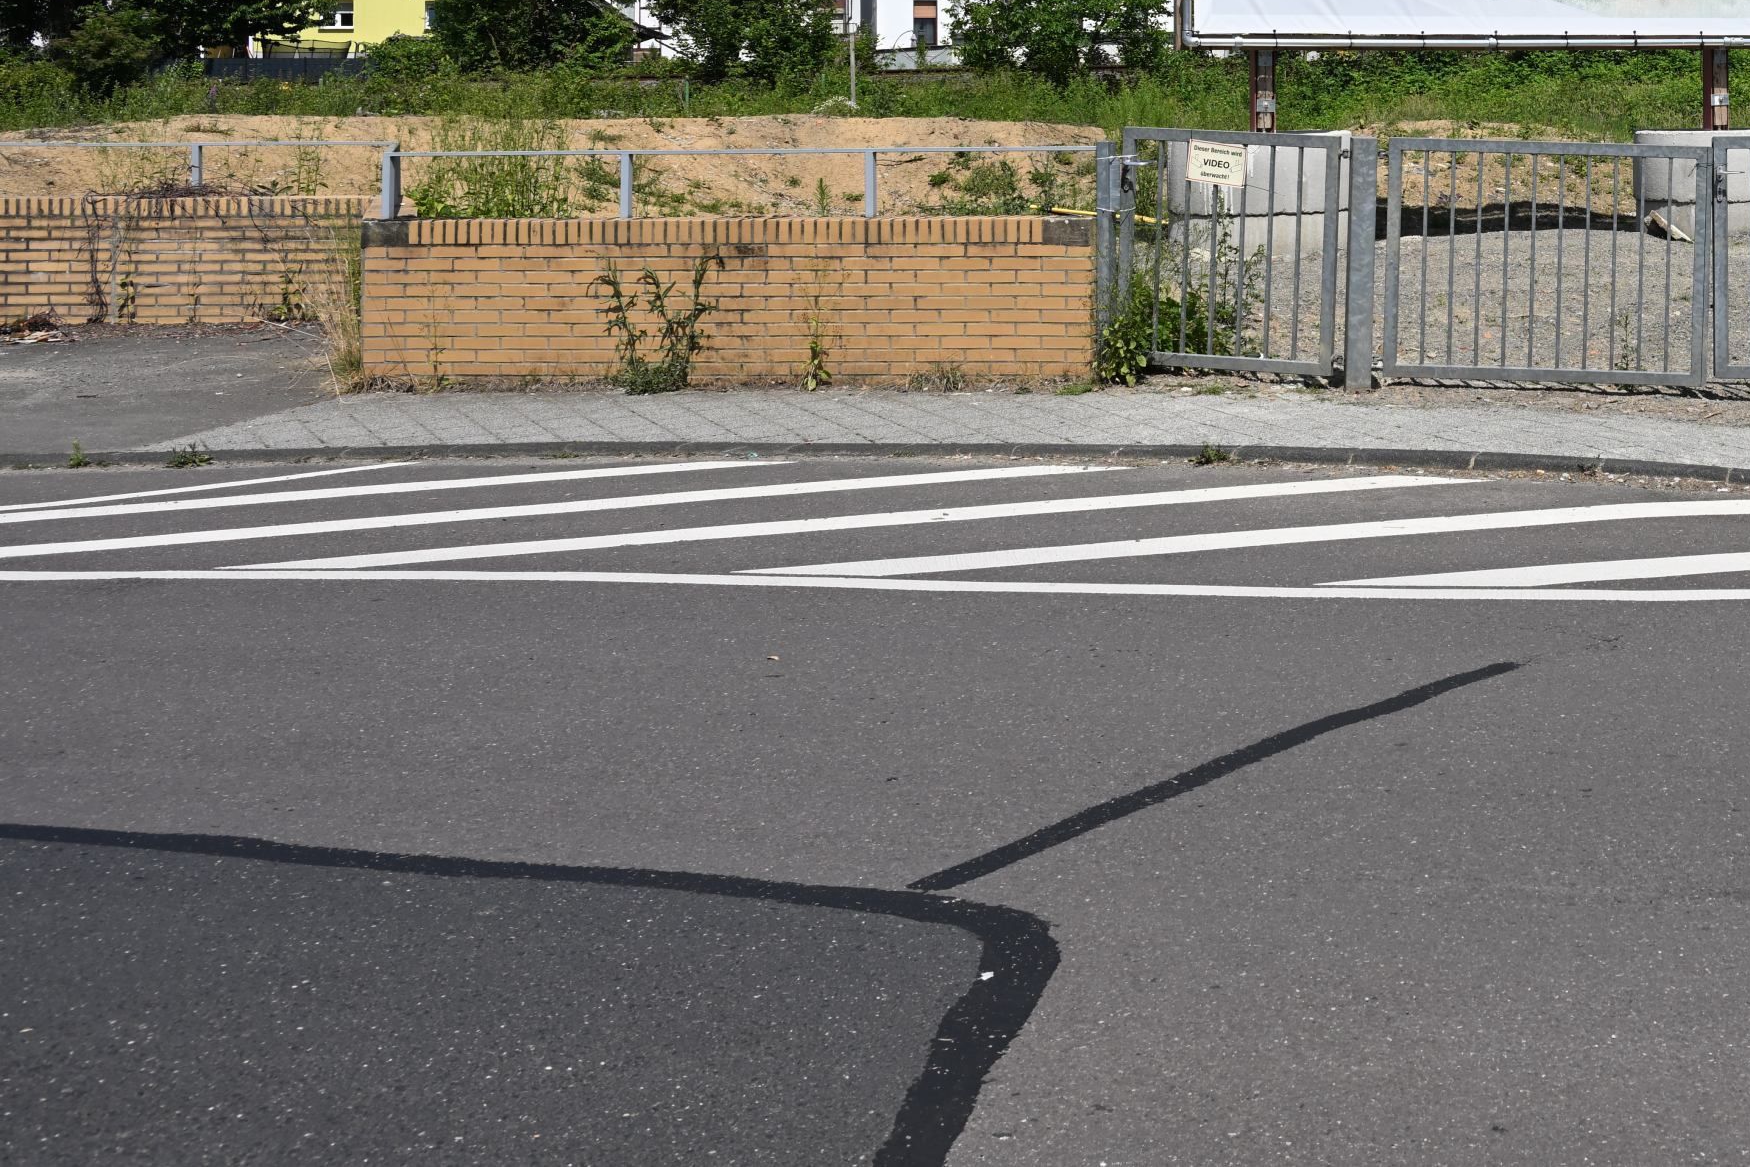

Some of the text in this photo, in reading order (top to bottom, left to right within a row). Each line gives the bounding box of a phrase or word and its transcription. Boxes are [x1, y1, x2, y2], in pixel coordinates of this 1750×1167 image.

[1211, 147, 1230, 155] Bereich
[1203, 159, 1230, 169] VIDEO
[1200, 171, 1230, 180] überwacht!
